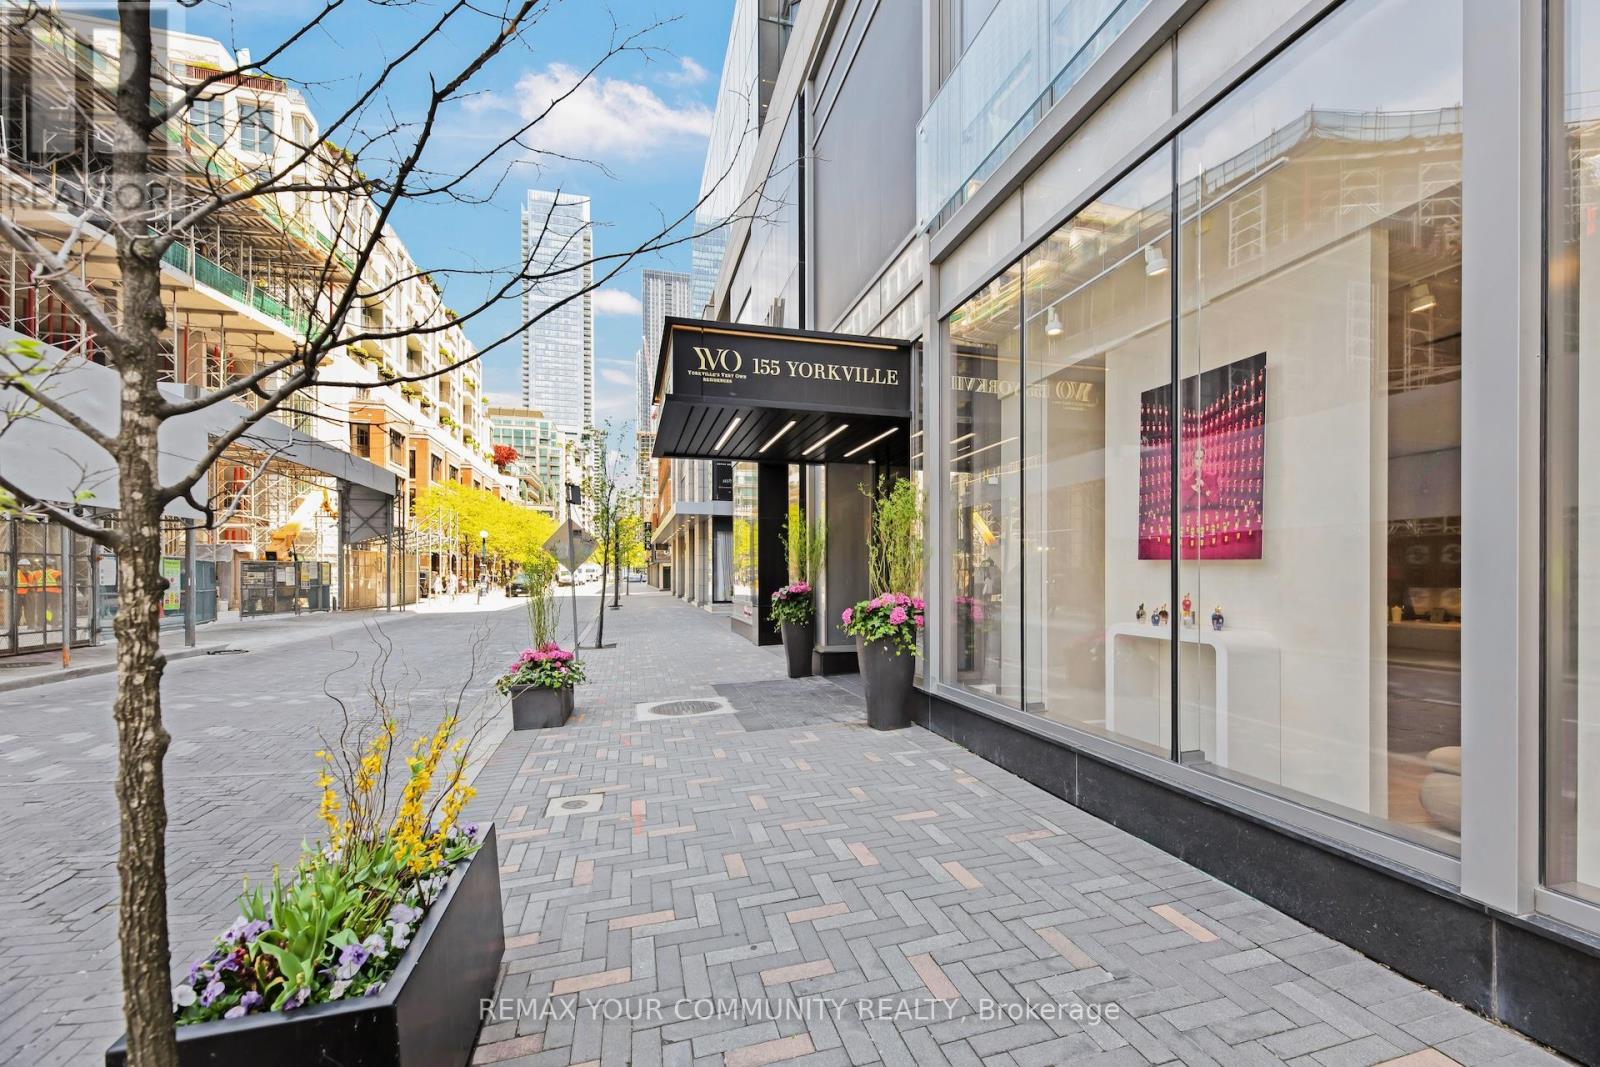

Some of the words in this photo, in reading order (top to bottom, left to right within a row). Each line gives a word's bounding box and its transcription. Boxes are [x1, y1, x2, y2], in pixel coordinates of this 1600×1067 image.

[692, 346, 742, 372] YVO
[752, 357, 781, 376] 155
[786, 361, 899, 386] YORKVILLE
